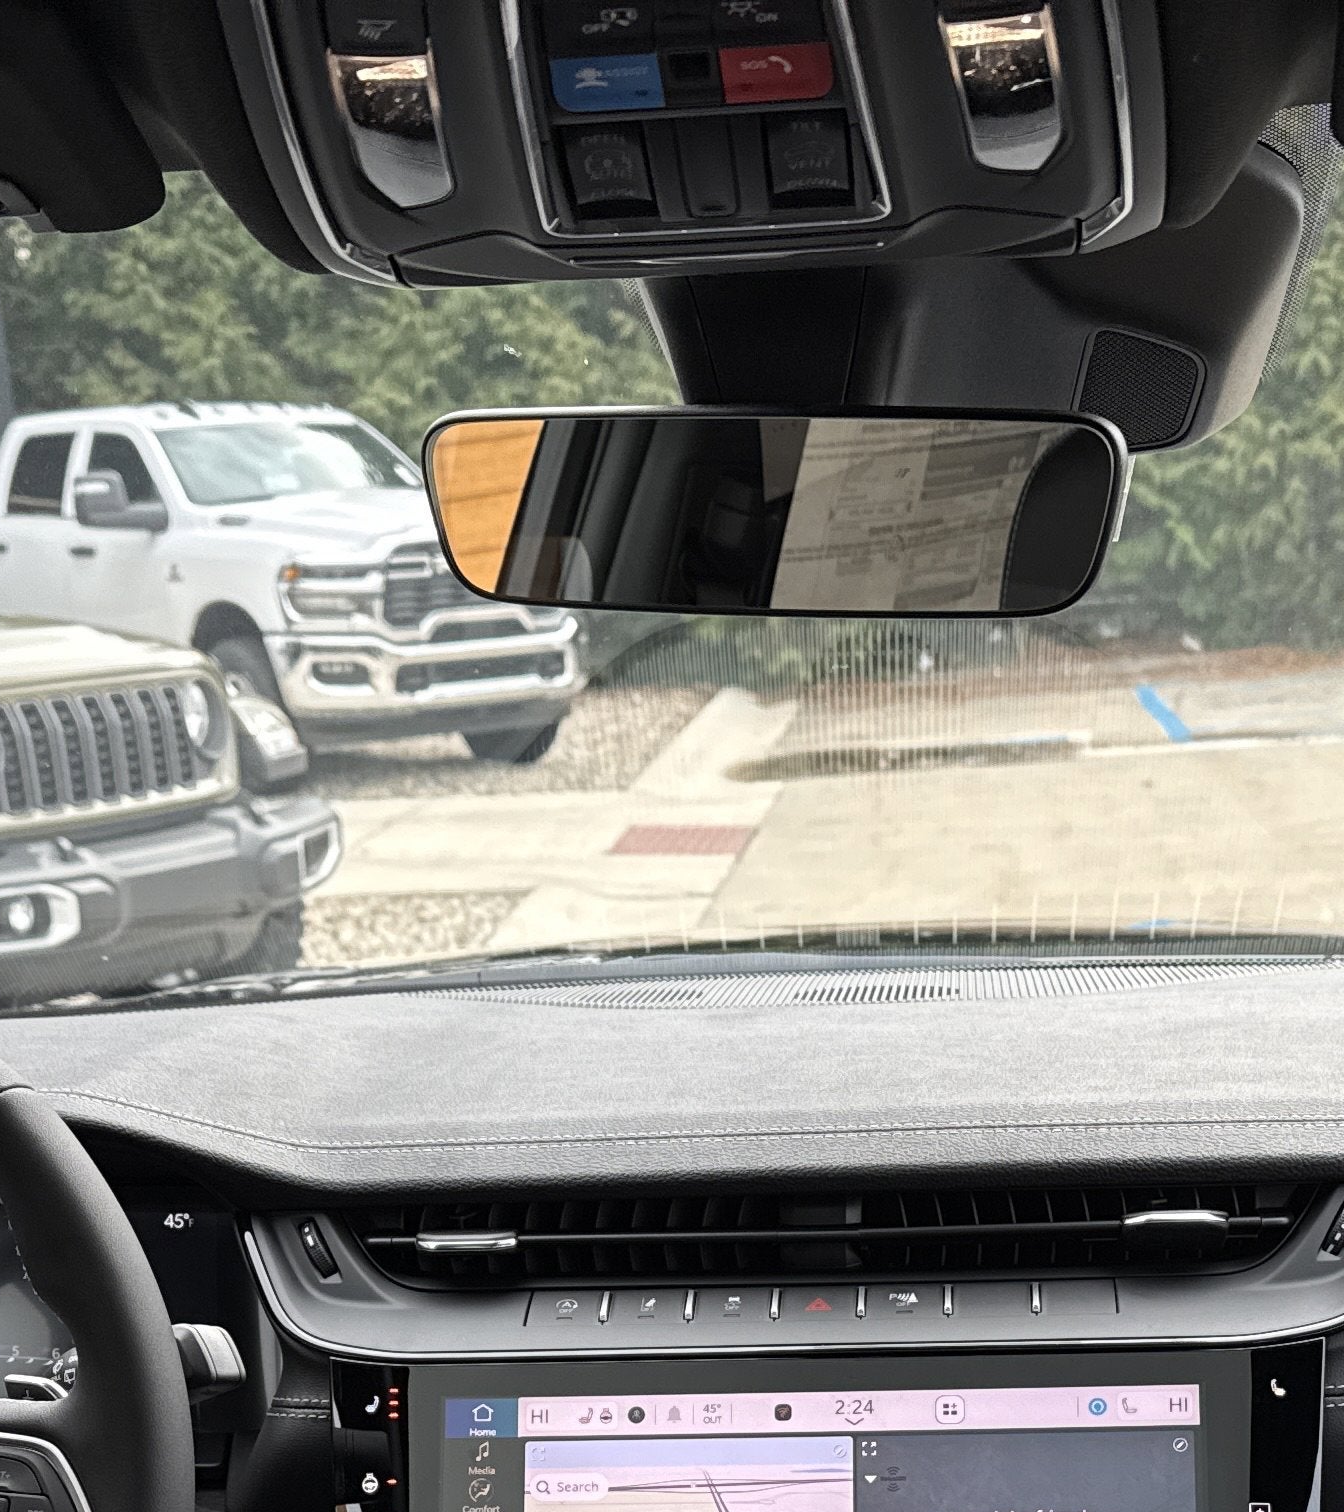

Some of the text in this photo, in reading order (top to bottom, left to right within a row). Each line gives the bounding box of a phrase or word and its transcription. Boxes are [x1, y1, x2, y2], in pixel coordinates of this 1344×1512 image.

[12, 1345, 20, 1357] 5
[51, 1348, 60, 1360] 6
[835, 1400, 874, 1415] 2:24
[1169, 1397, 1188, 1412] HI
[531, 1409, 549, 1423] HI
[703, 1416, 721, 1424] OUT
[469, 1428, 496, 1437] Home
[468, 1466, 496, 1476] Media
[556, 1481, 599, 1493] Search
